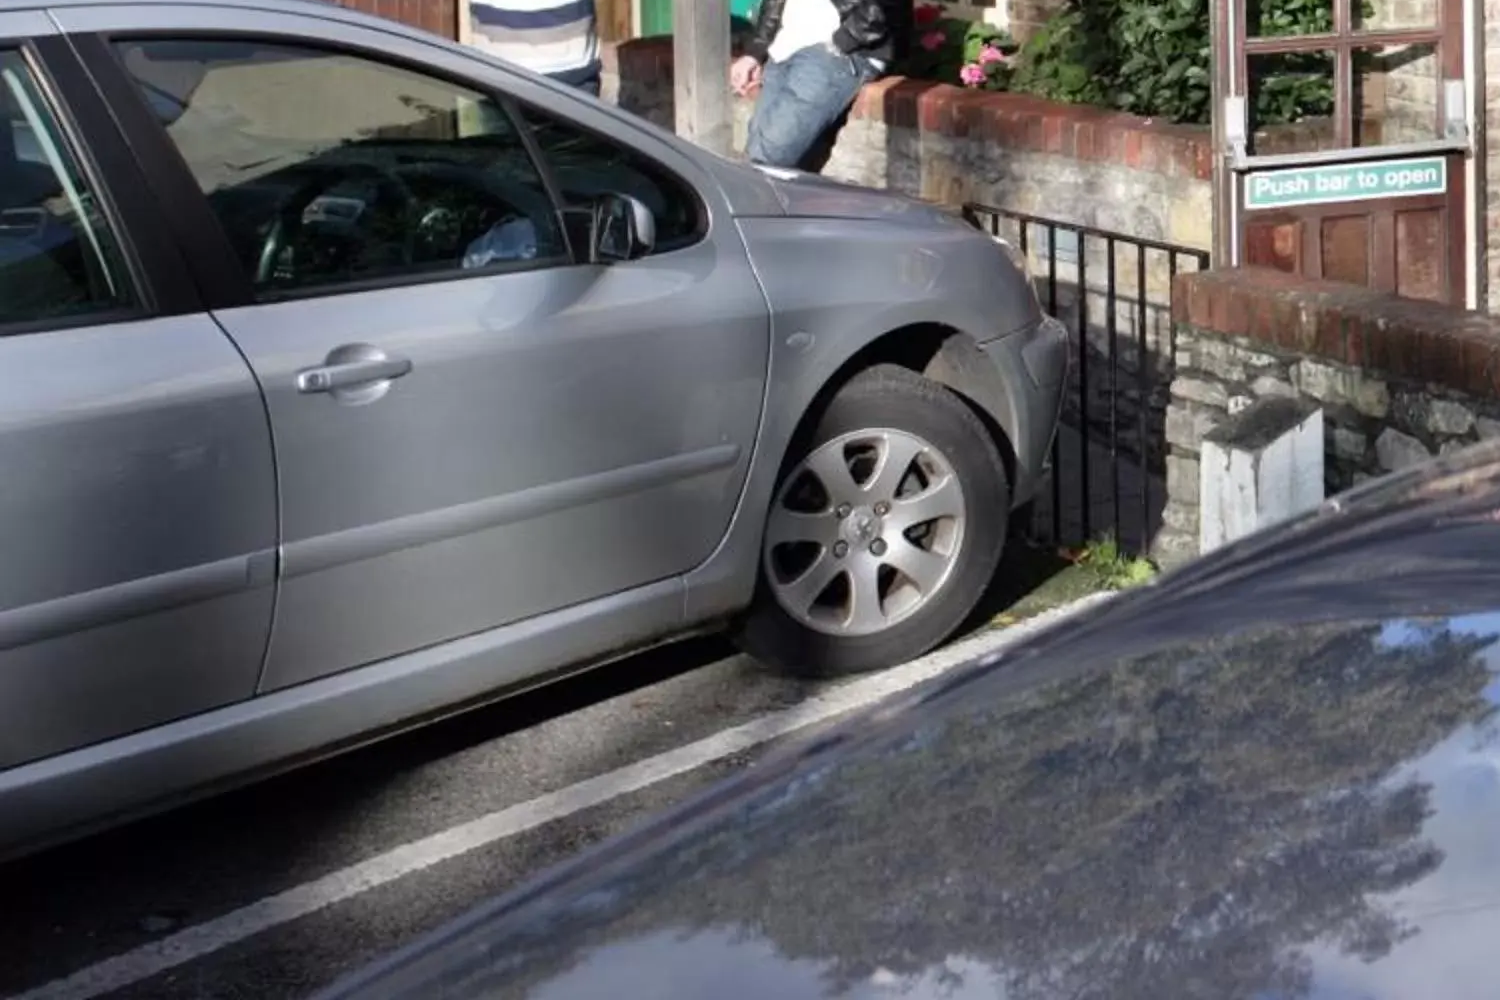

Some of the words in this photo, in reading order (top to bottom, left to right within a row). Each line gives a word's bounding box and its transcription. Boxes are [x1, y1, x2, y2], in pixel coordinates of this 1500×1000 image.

[1255, 175, 1309, 198] Push
[1314, 173, 1352, 193] bar
[1356, 170, 1380, 187] to
[1384, 166, 1438, 189] open
